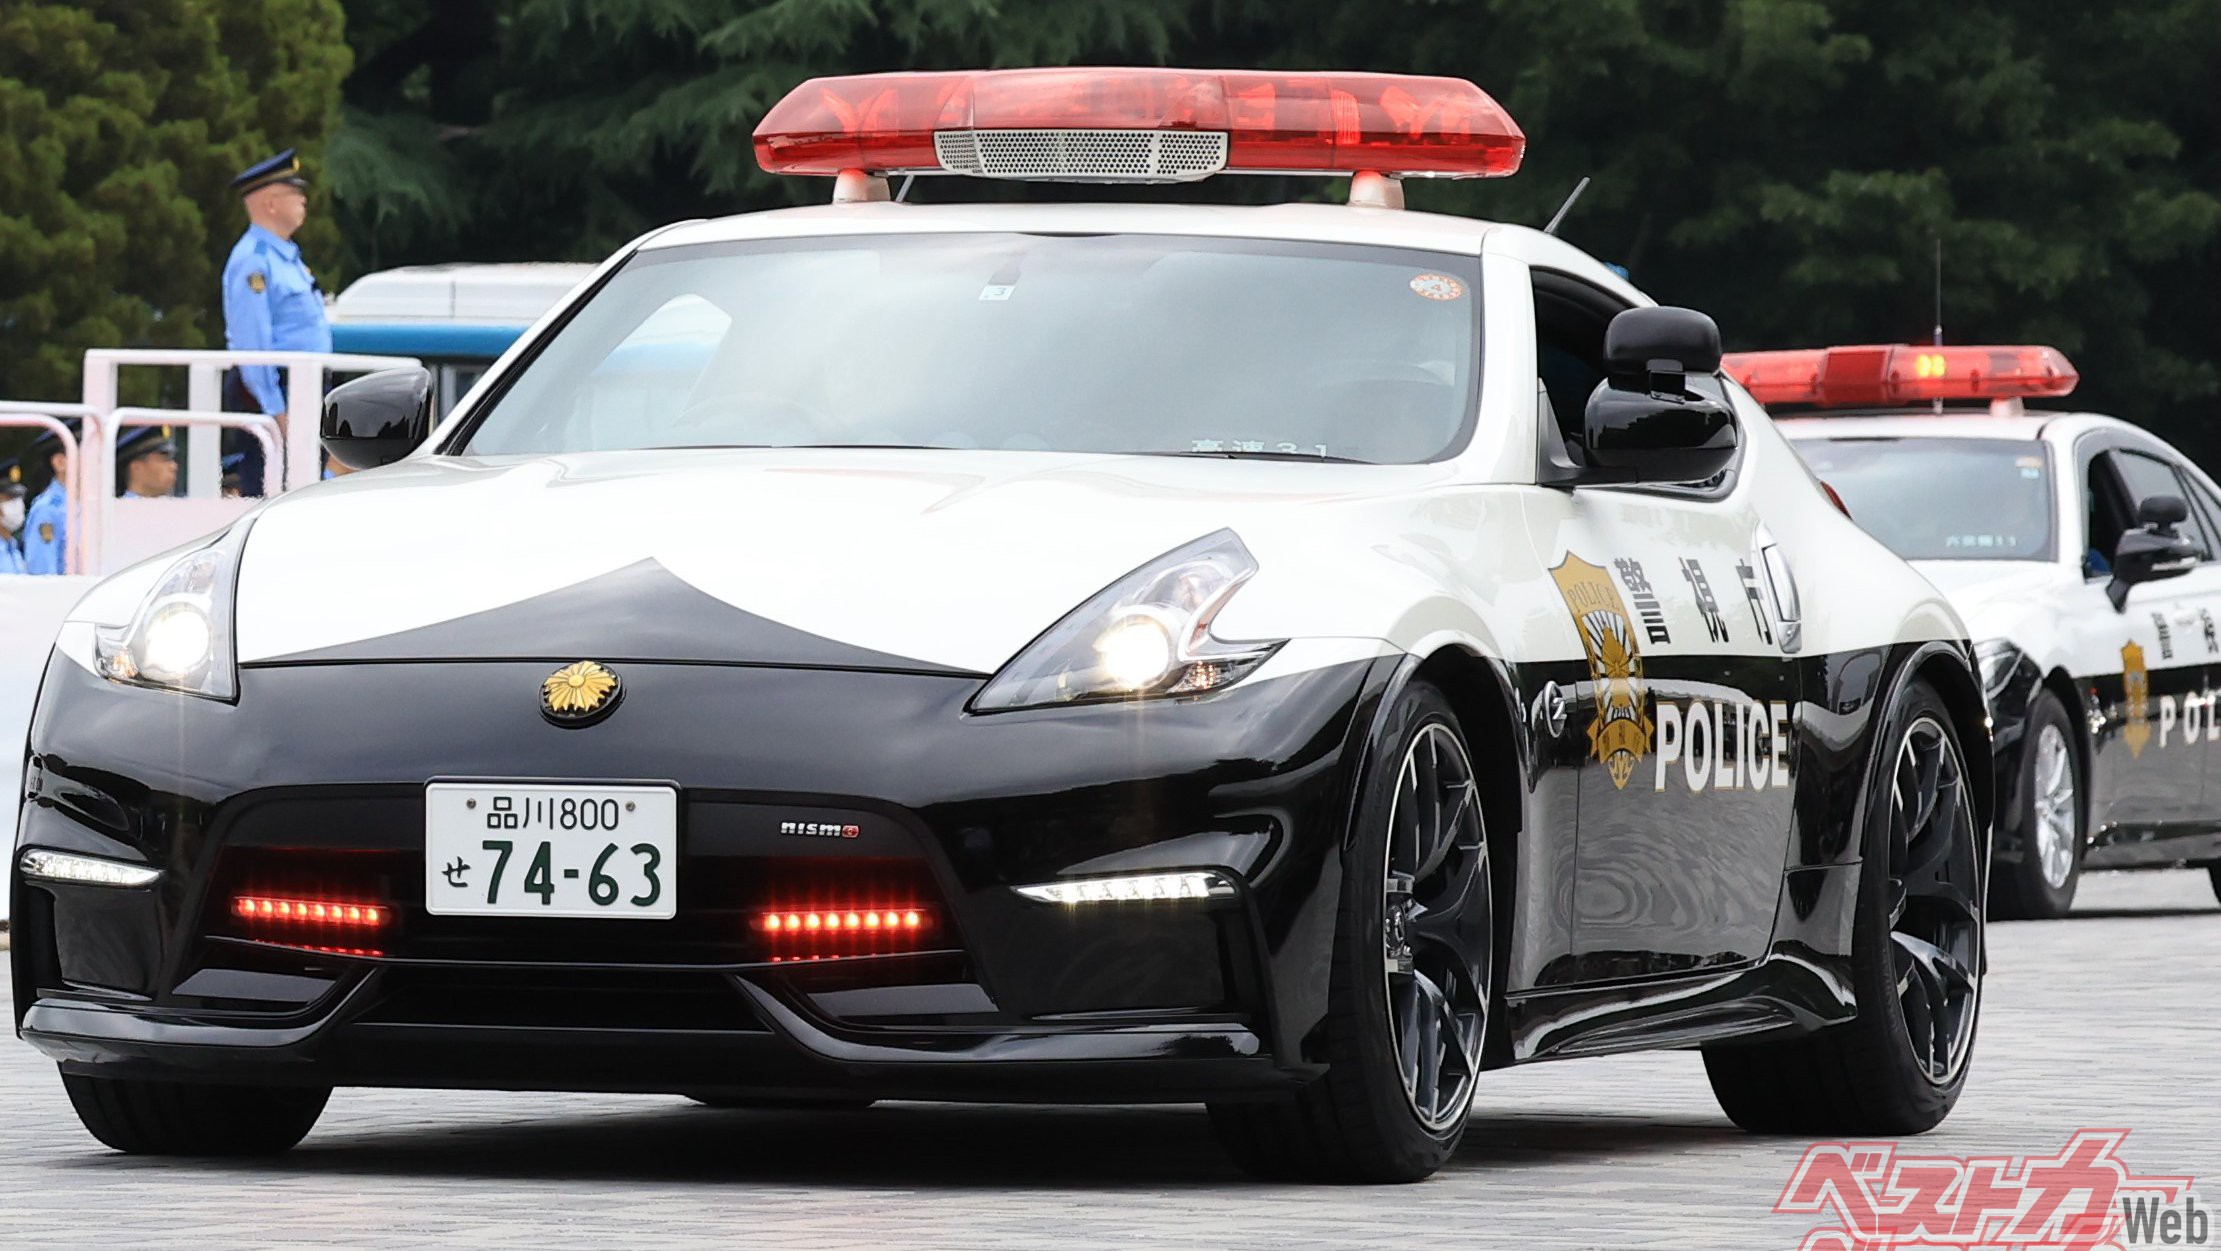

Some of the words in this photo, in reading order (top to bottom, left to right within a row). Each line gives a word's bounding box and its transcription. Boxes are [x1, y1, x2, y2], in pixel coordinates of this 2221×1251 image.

[1613, 556, 1773, 645] 警視庁
[1654, 699, 1790, 793] POLICE
[441, 856, 471, 888] せ
[482, 840, 661, 906] 74-63
